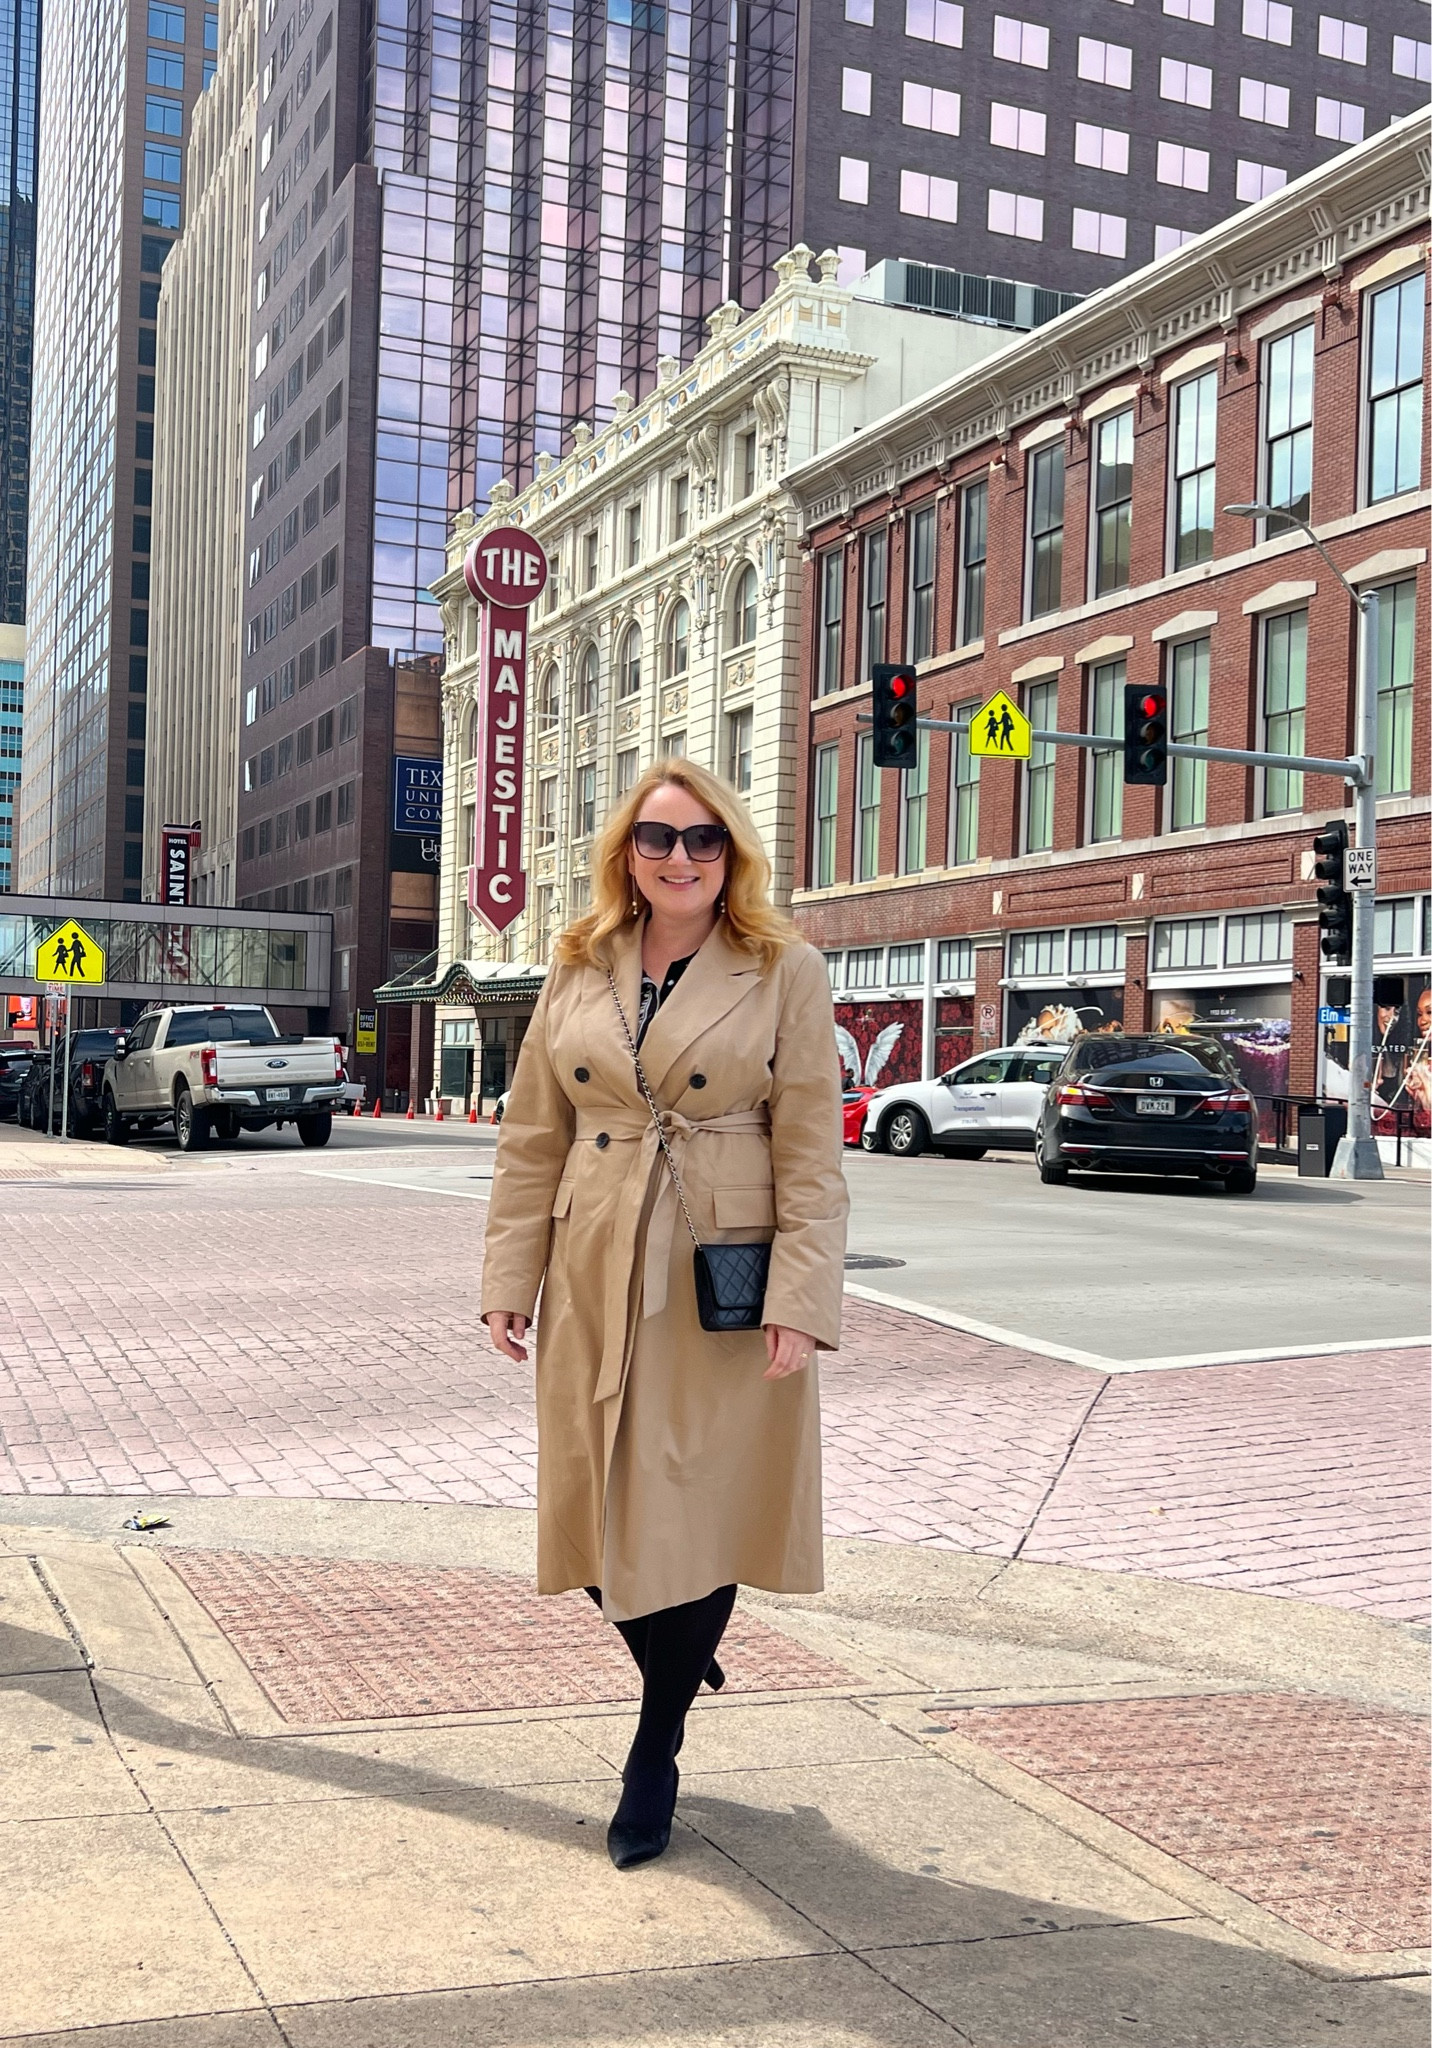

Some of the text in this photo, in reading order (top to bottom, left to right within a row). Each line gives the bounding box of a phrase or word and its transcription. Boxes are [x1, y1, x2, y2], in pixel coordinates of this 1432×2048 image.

[481, 547, 541, 587] THE
[488, 628, 522, 904] MAJESTIC
[1348, 851, 1373, 862] ONE
[1348, 863, 1373, 874] WAY
[359, 1014, 375, 1022] OFFICE
[1321, 1008, 1339, 1022] Elm
[359, 1021, 374, 1029] SPACE
